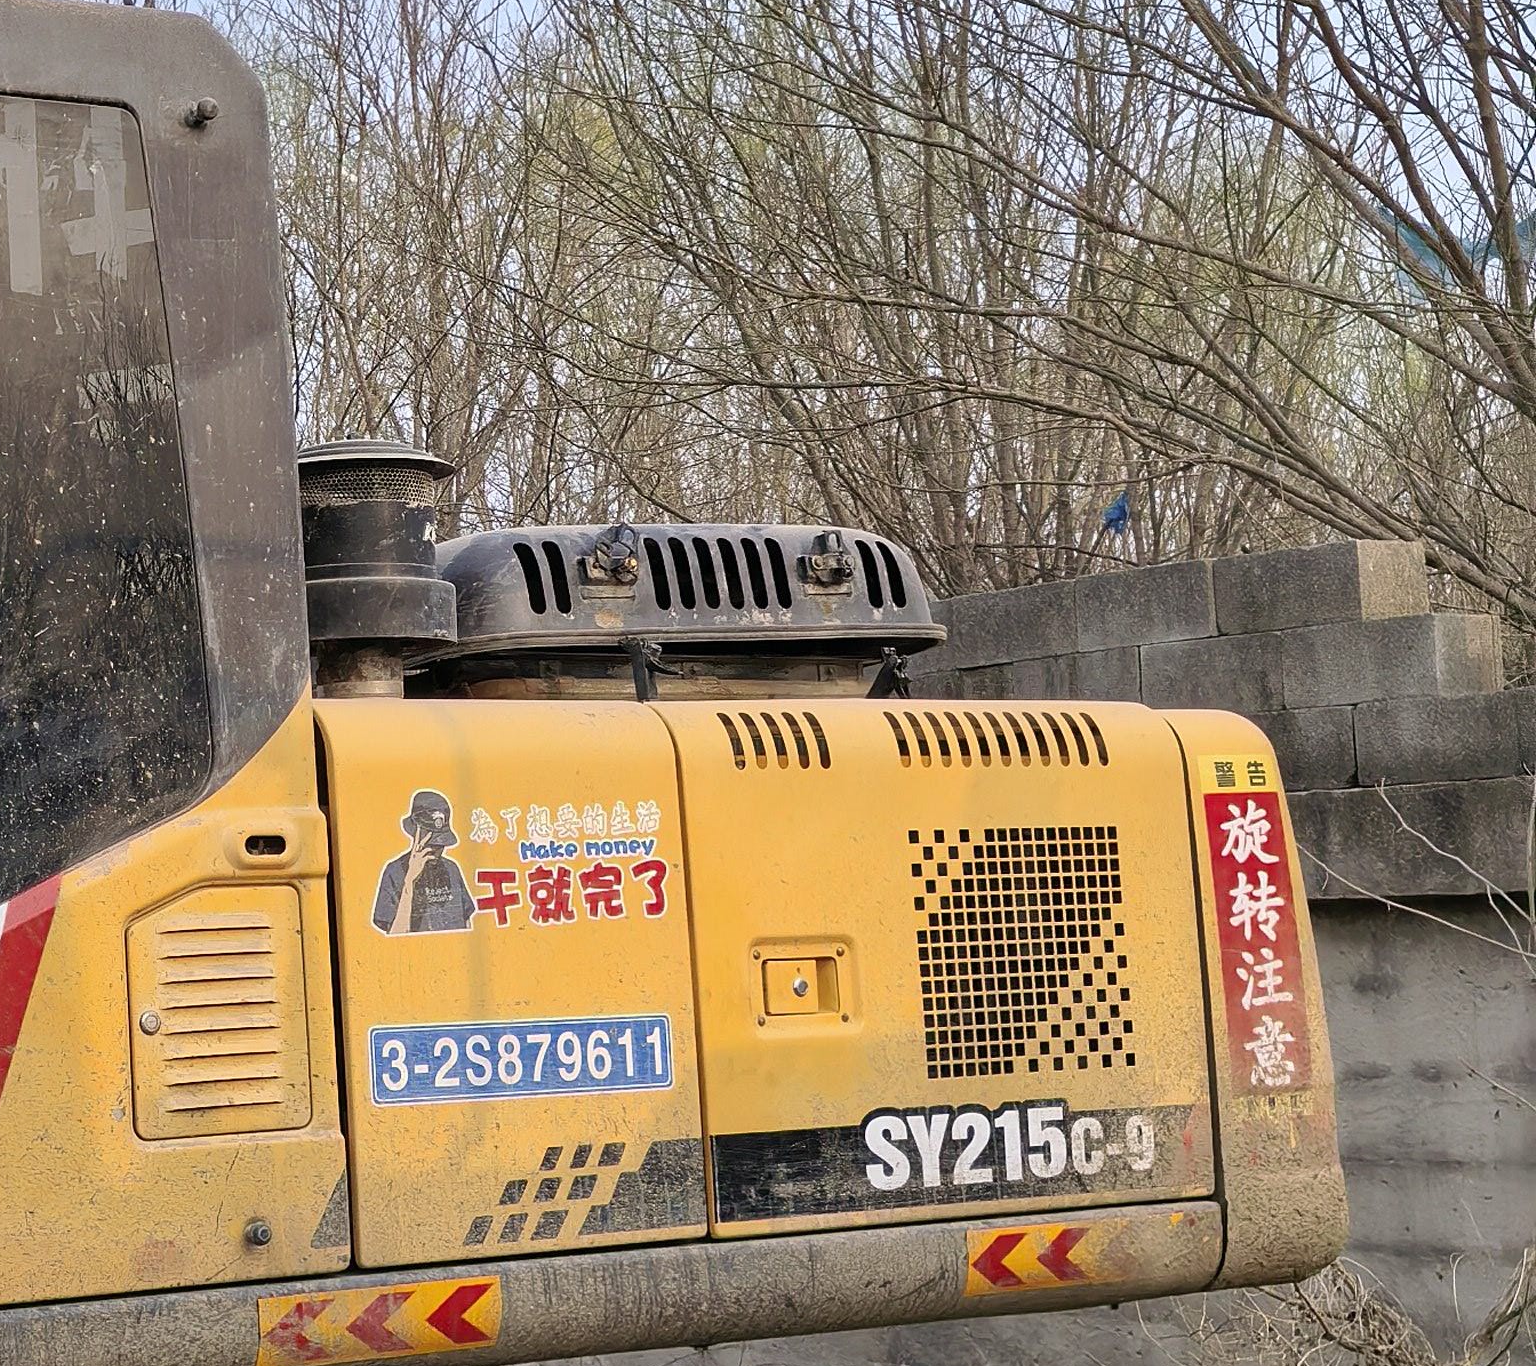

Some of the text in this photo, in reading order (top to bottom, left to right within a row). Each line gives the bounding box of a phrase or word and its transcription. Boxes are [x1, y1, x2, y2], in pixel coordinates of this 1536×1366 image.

[1214, 760, 1267, 788] 警告
[469, 800, 662, 843] 為了想要的生活
[520, 839, 655, 860] Make money
[476, 860, 667, 925] 干就完了
[1220, 799, 1296, 1086] 旋转注意
[381, 1026, 664, 1092] 3-2S879611
